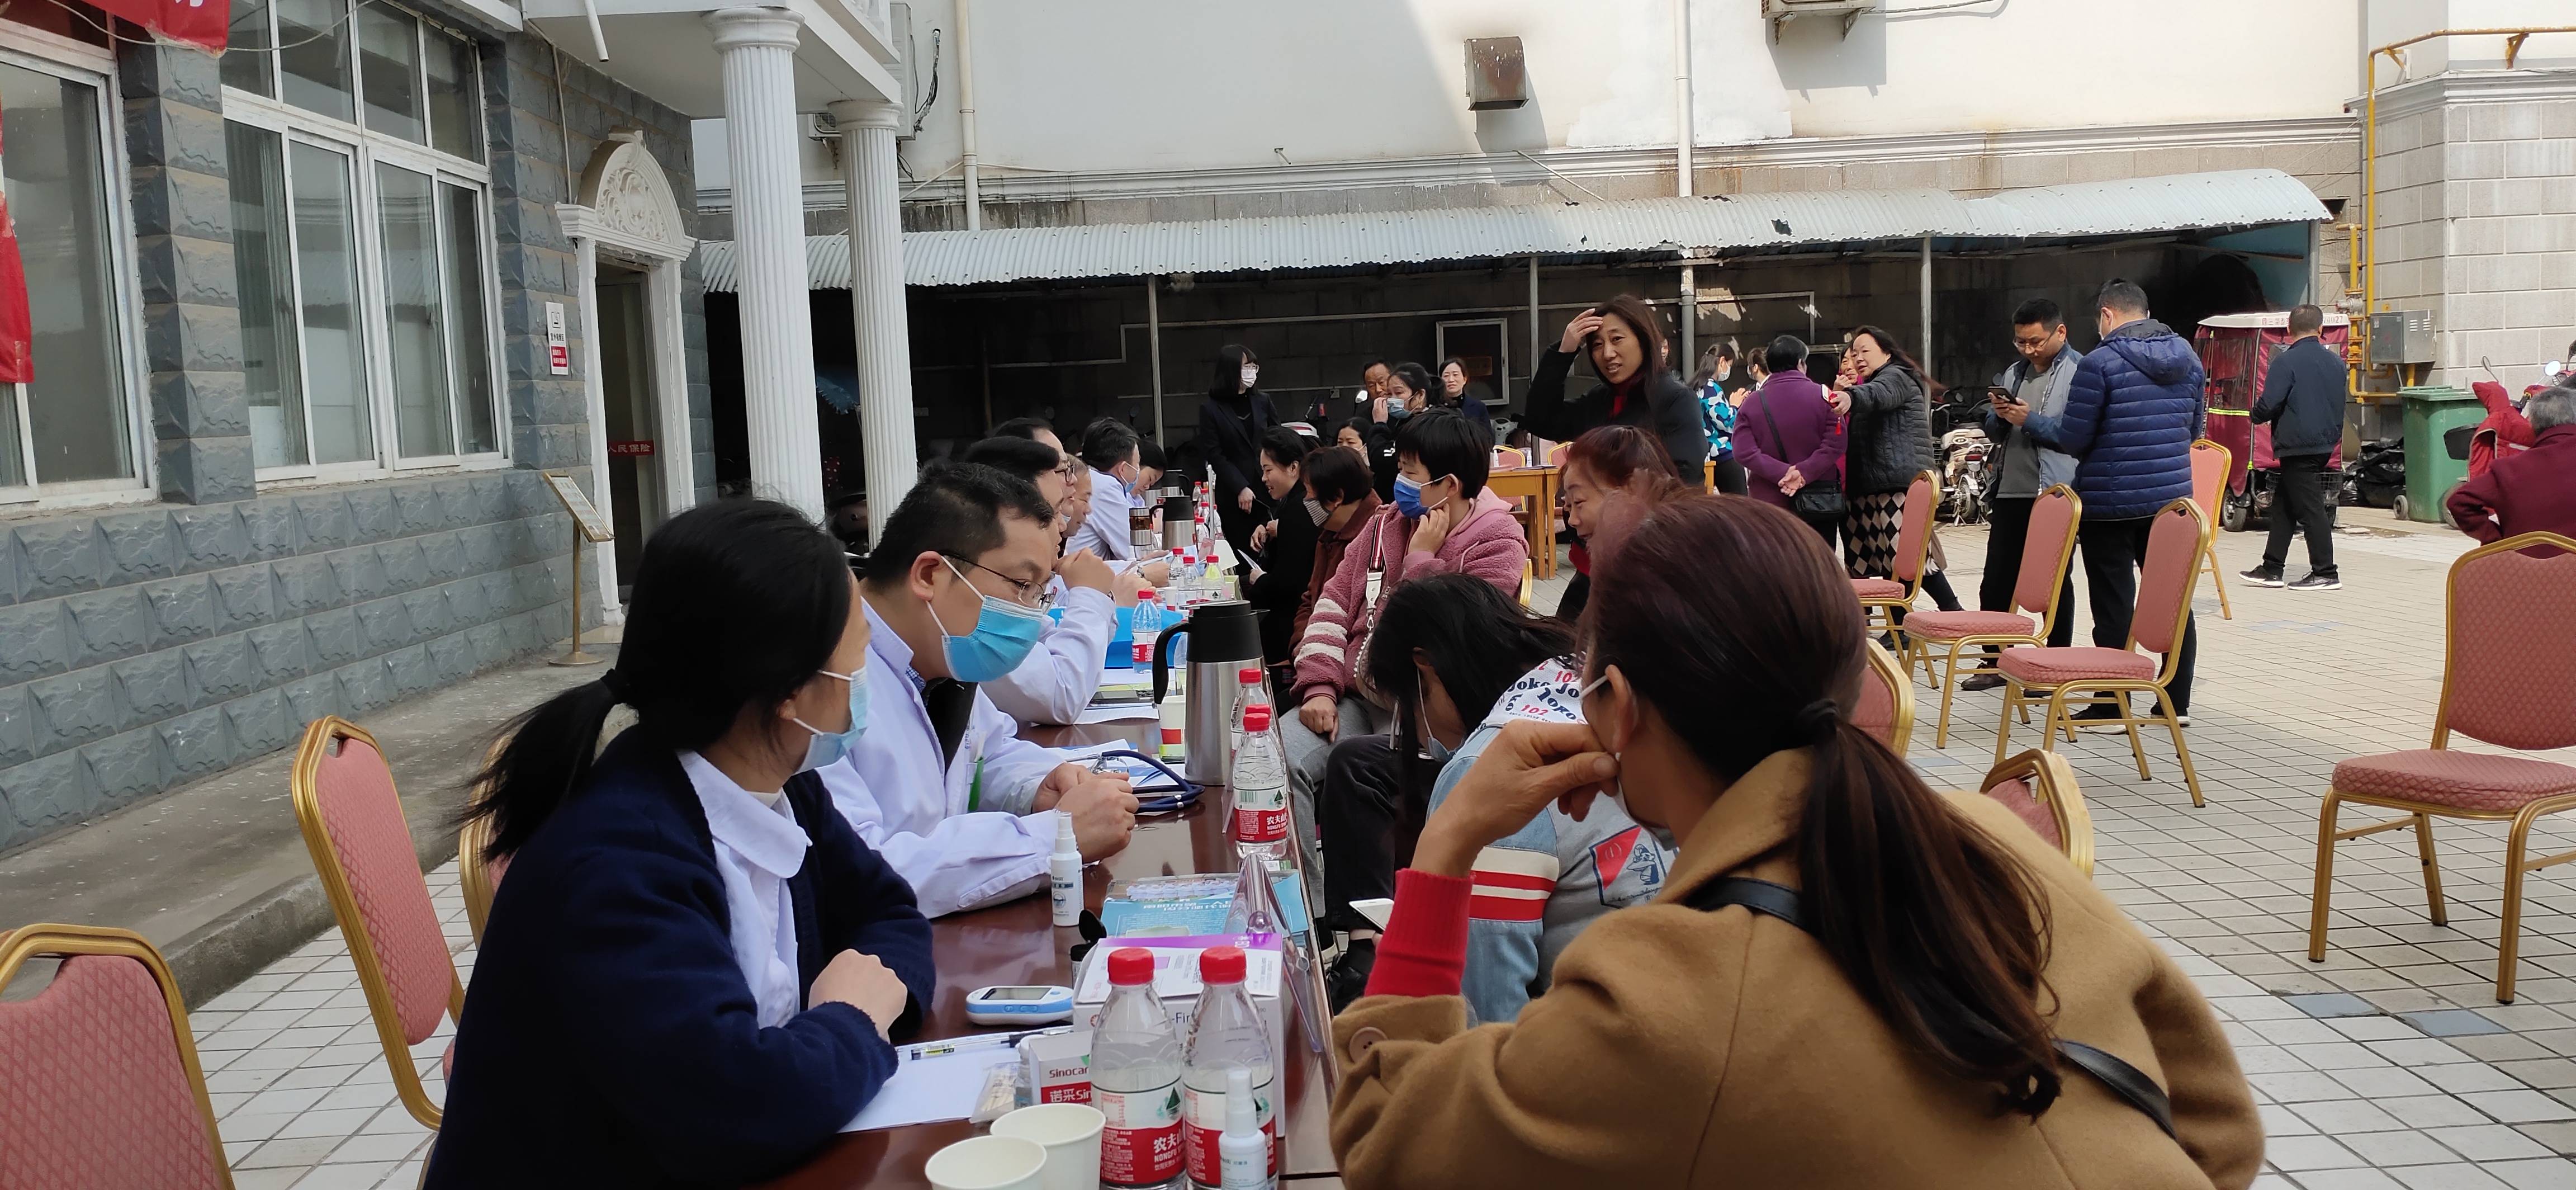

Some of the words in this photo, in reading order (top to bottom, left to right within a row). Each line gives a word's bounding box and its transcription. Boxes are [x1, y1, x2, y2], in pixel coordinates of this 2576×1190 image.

[1555, 670, 1581, 683] 10
[1521, 705, 1549, 716] 102
[1154, 1149, 1177, 1163] NONGFU
